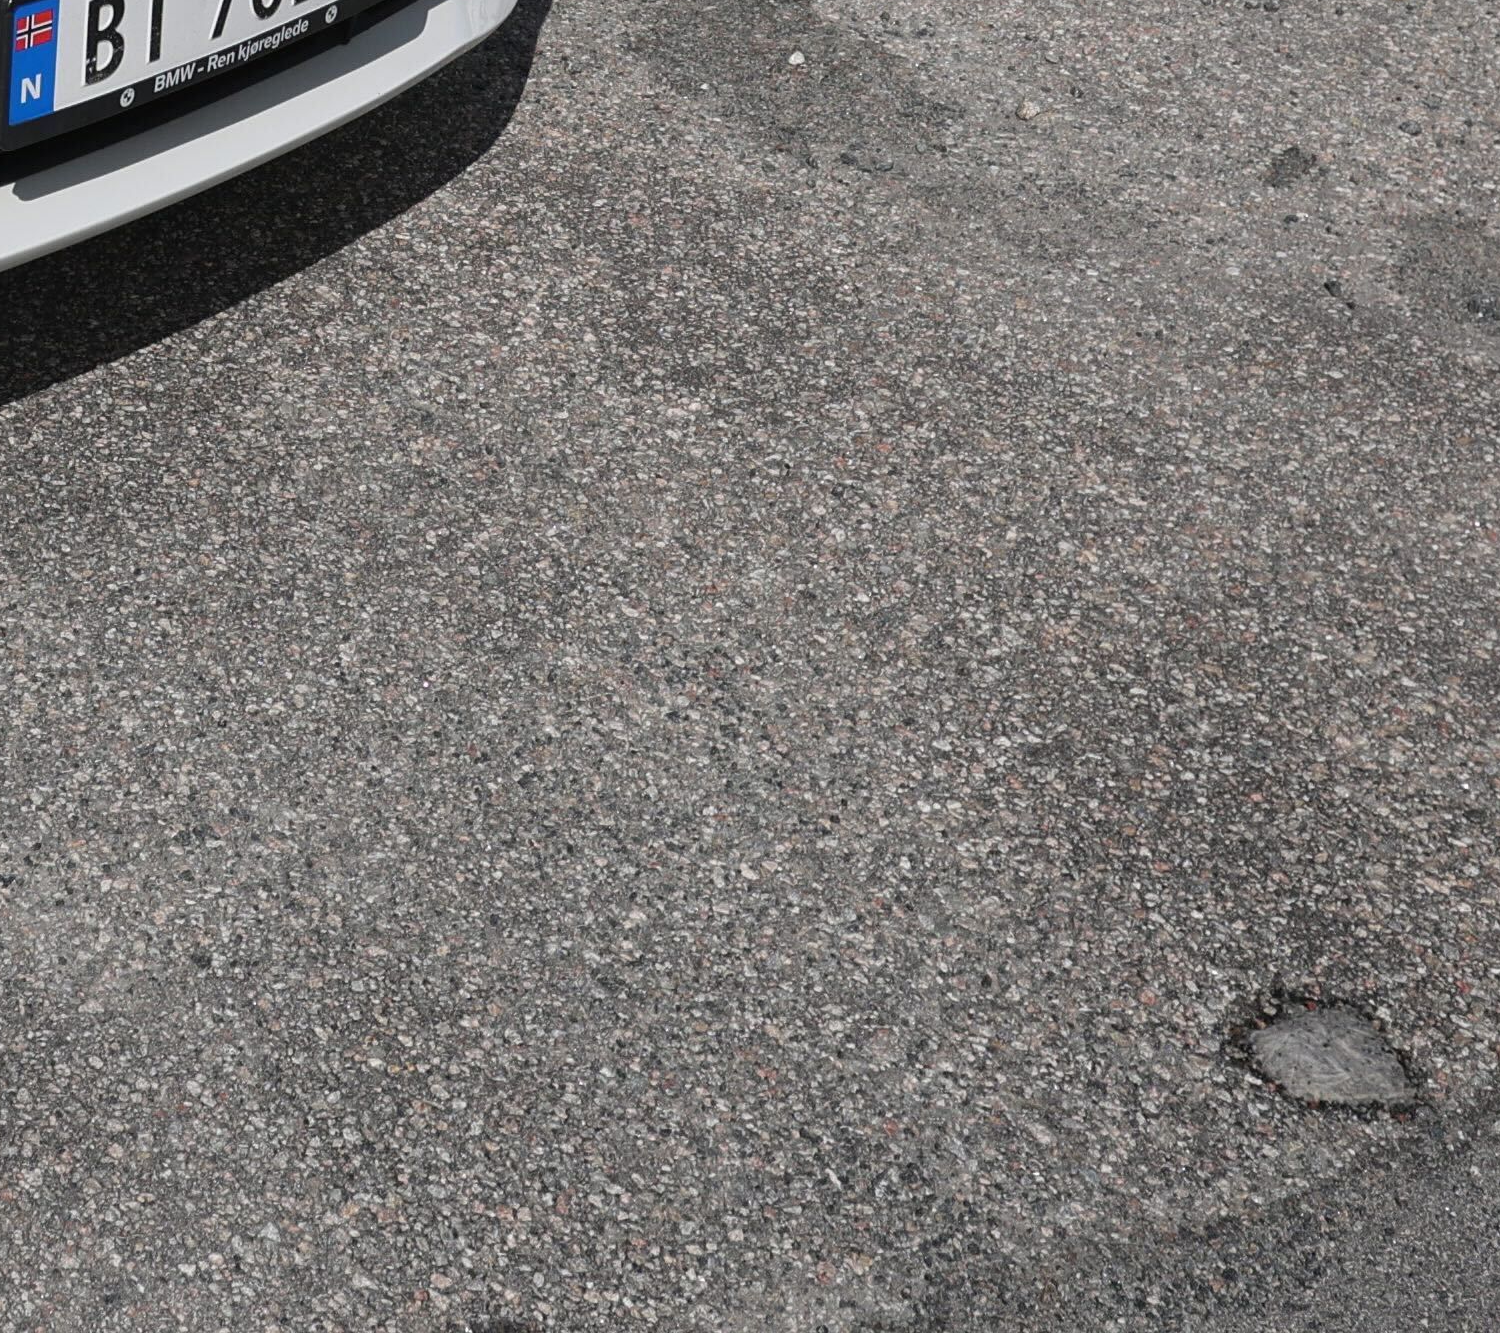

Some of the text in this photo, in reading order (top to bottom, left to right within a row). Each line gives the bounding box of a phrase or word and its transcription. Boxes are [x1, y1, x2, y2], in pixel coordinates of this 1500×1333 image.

[154, 62, 196, 93] BMW
[207, 51, 235, 73] Ren
[238, 19, 309, 62] kjøreglede
[21, 74, 42, 105] N
